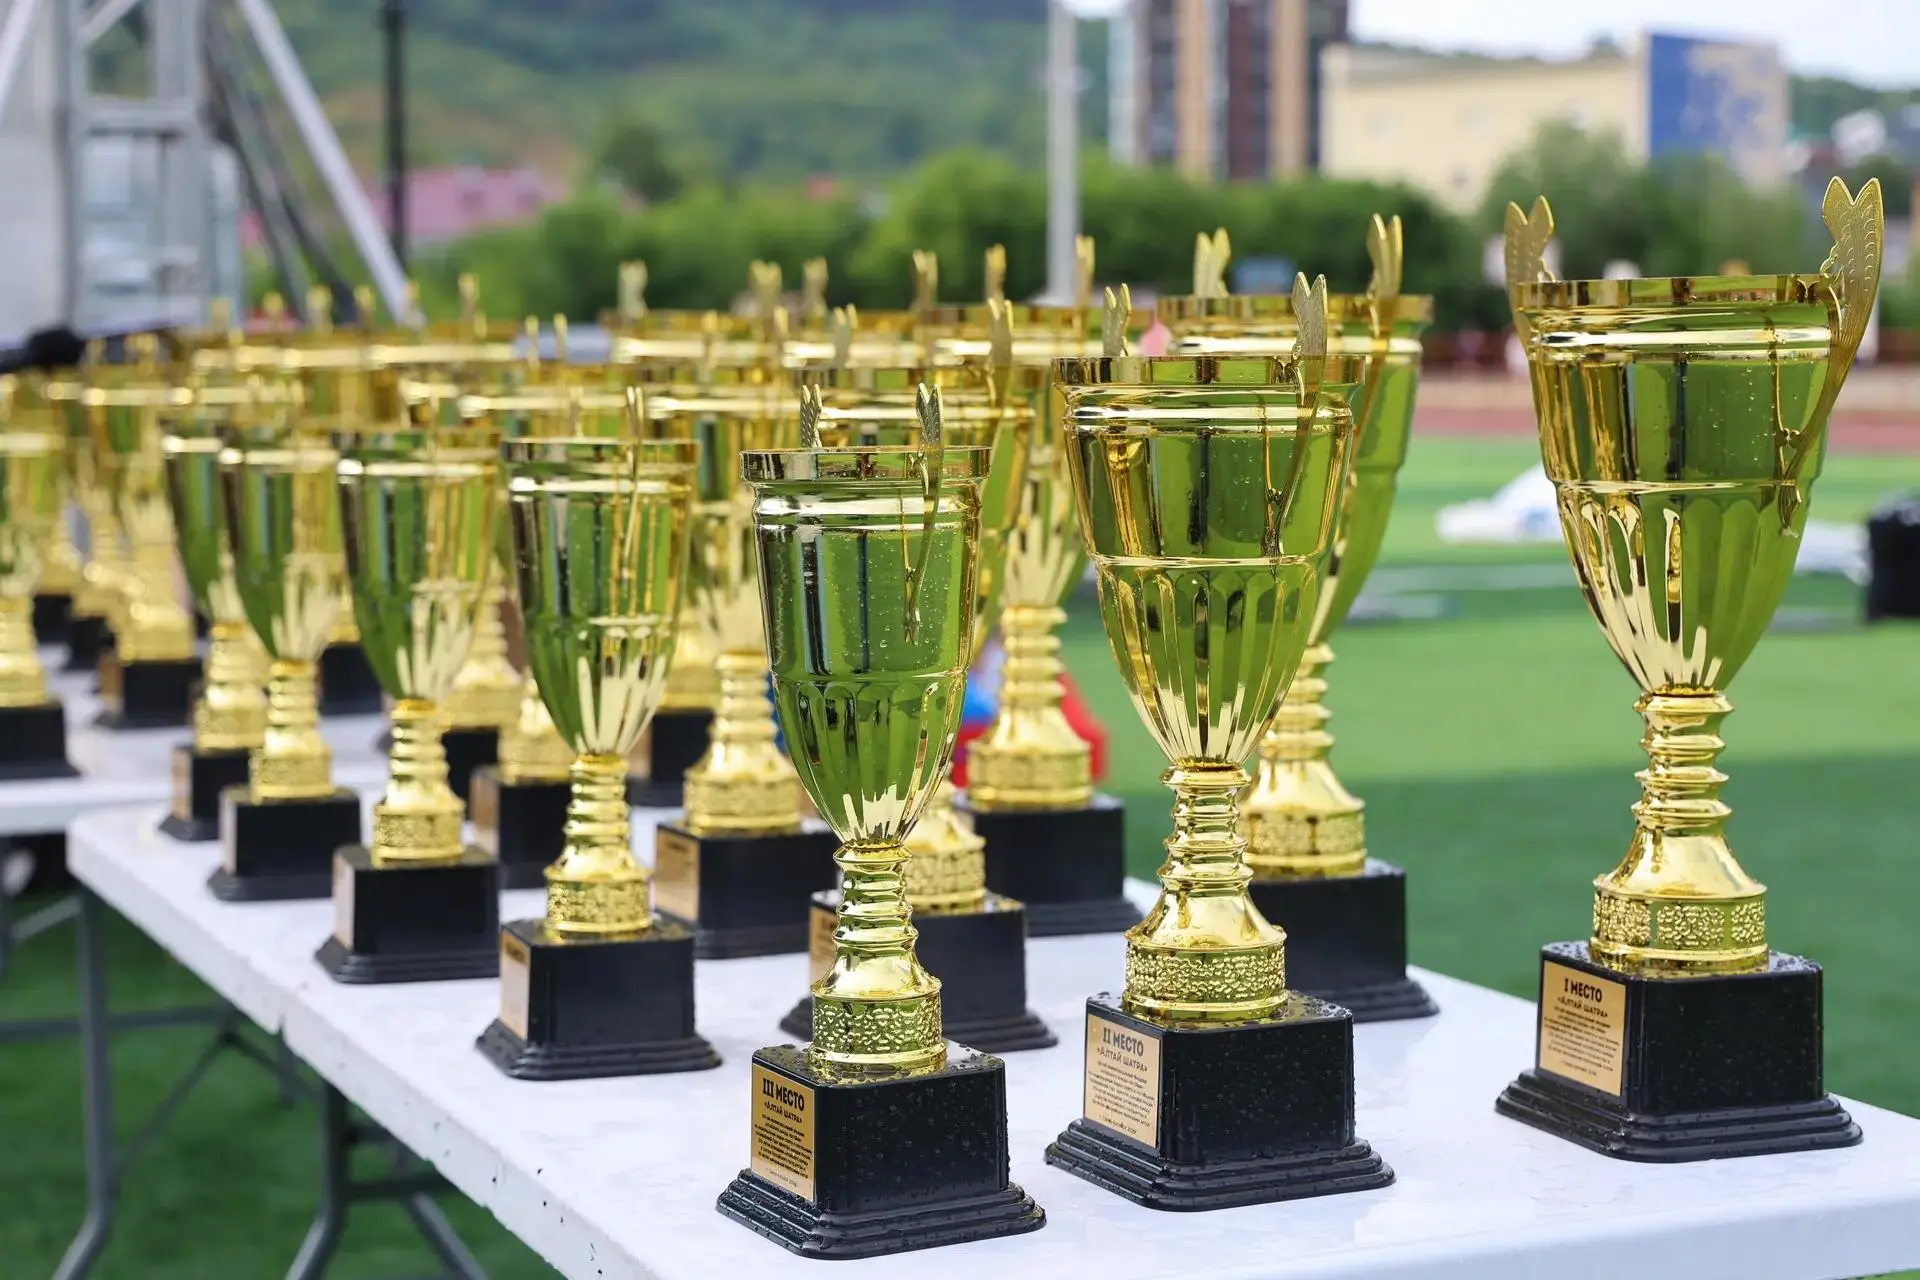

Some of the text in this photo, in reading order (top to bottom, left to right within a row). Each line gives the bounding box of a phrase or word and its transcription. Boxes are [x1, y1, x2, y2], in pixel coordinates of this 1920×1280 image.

[1564, 978, 1603, 1003] I МЕСТО
[1102, 1027, 1144, 1057] II МЕСТО
[762, 1077, 805, 1112] III МЕСТО
